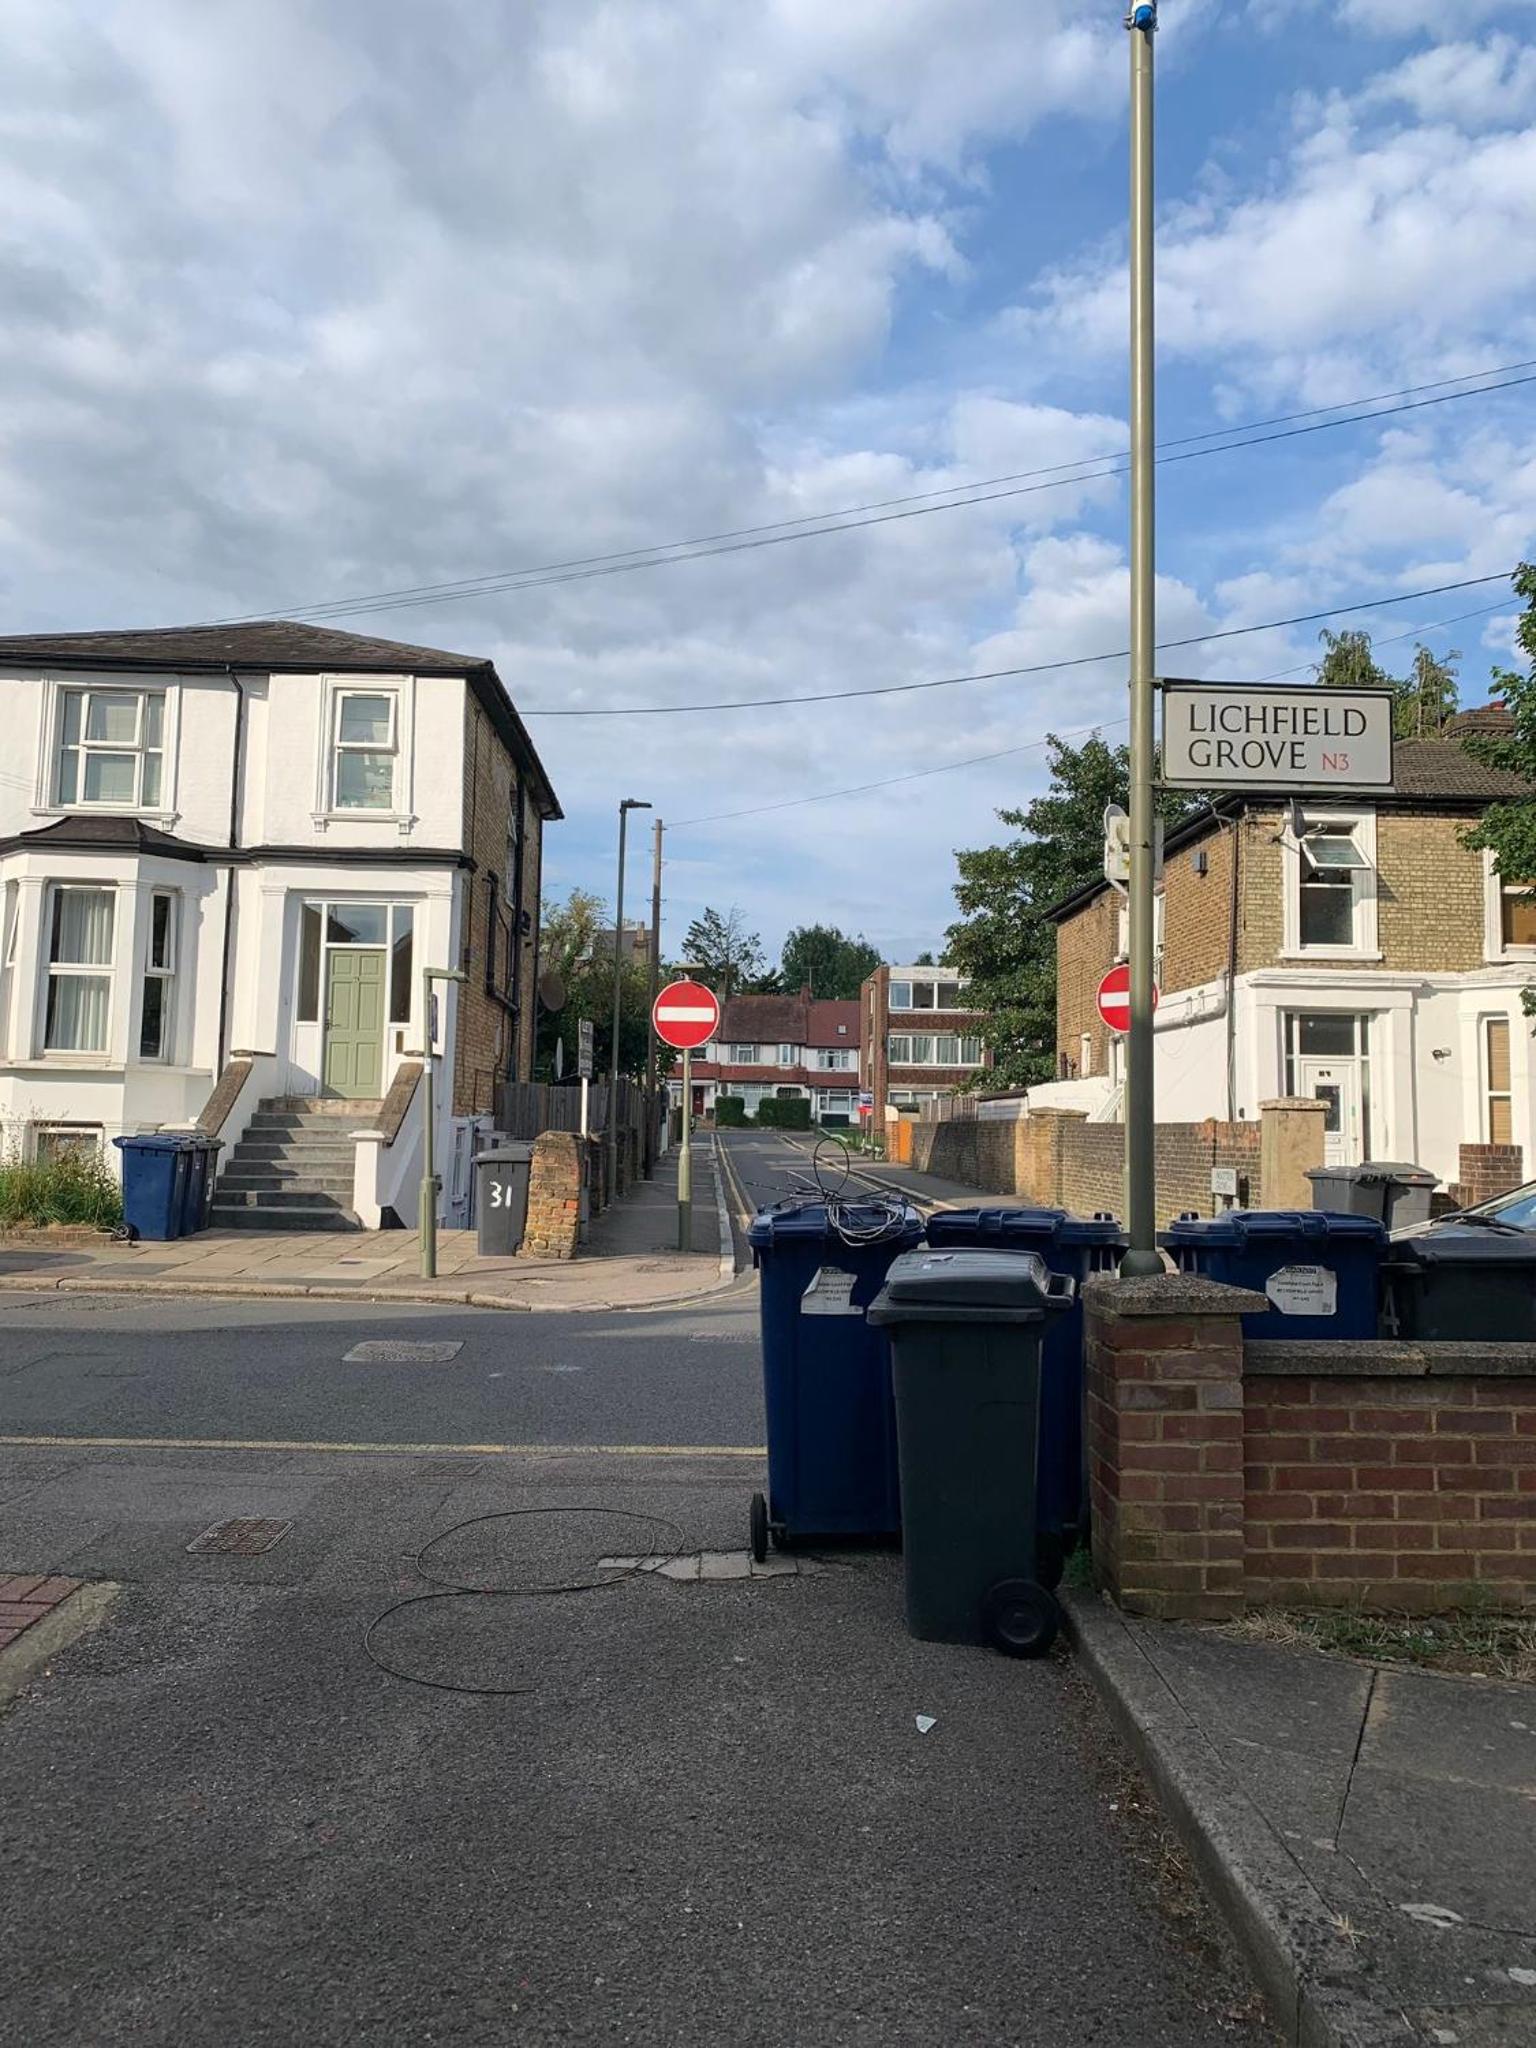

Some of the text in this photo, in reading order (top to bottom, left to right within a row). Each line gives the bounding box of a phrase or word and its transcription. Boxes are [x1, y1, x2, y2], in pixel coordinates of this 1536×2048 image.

[1189, 703, 1367, 737] LICHFIELD
[1189, 739, 1351, 771] GROVE N3
[489, 1180, 513, 1208] 31
